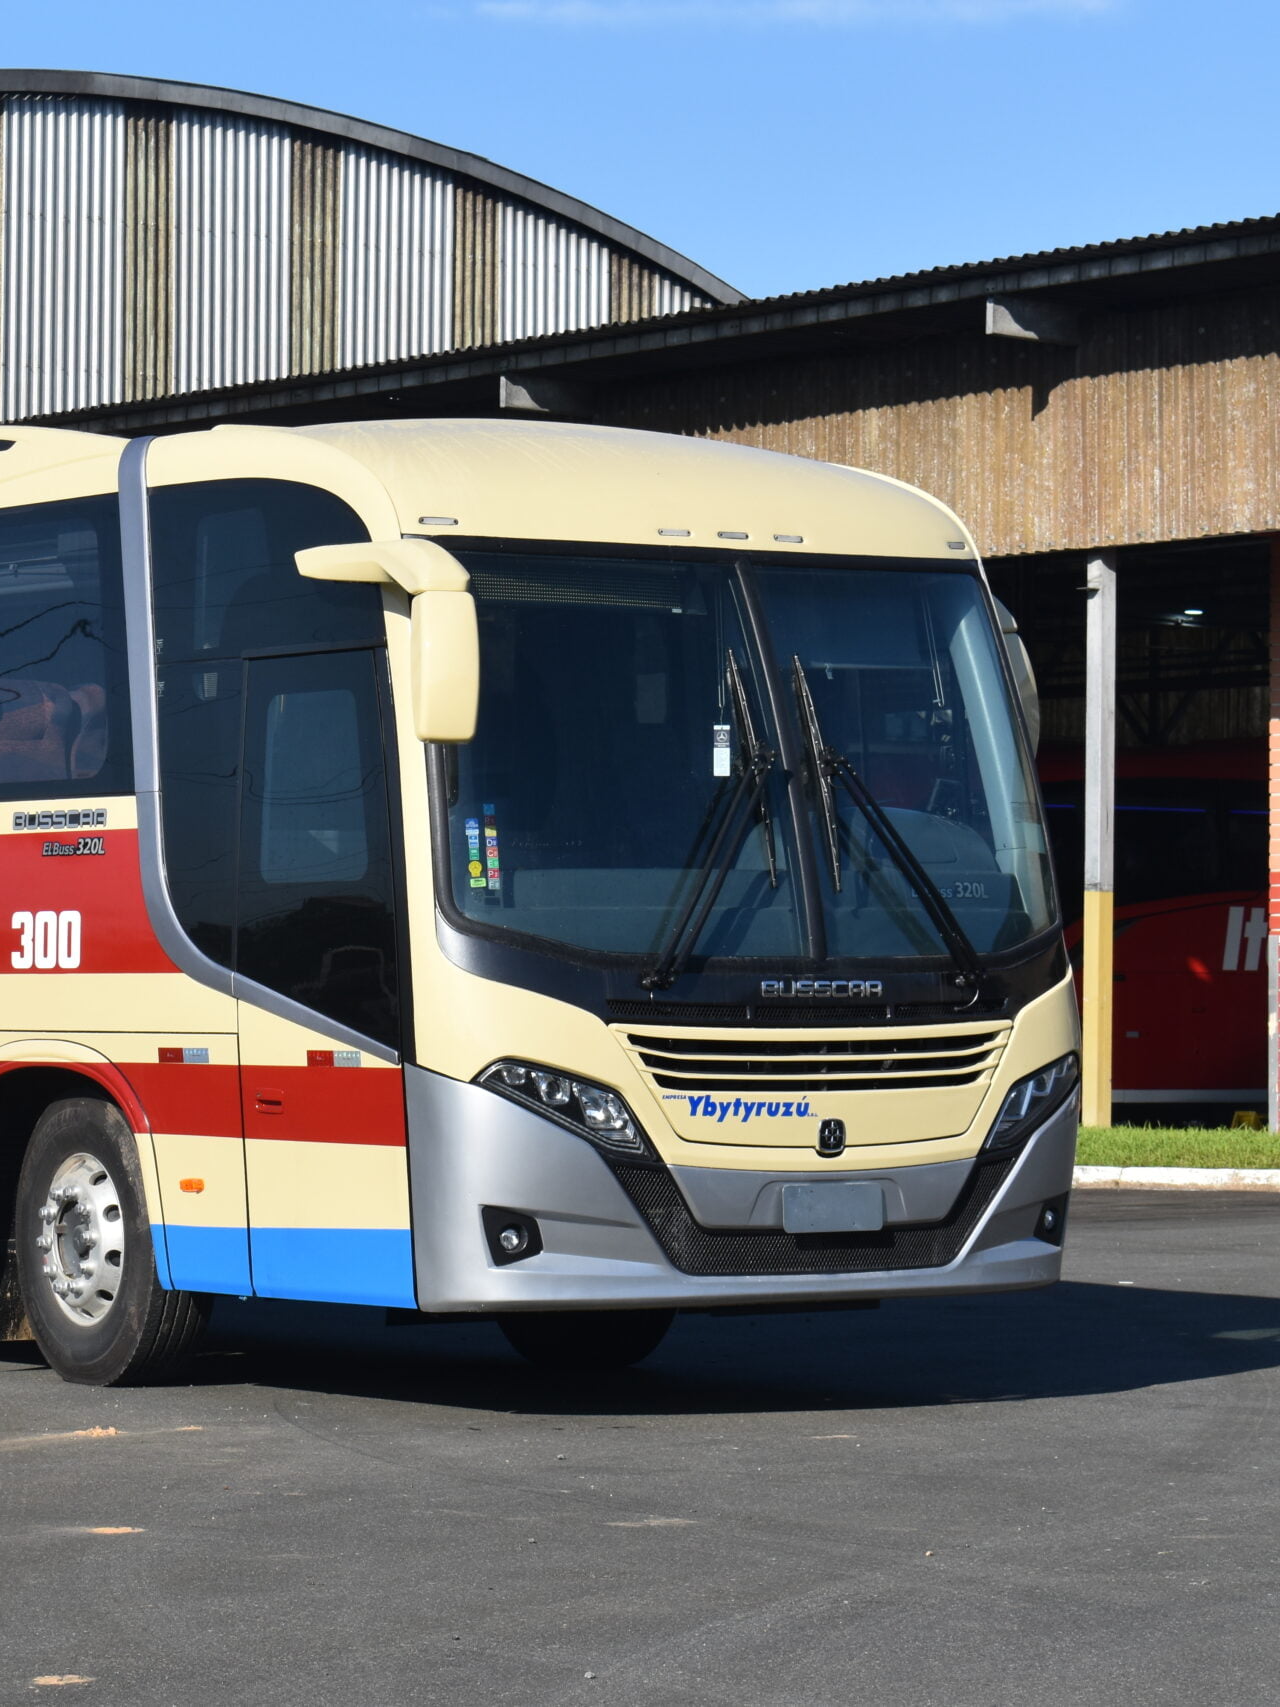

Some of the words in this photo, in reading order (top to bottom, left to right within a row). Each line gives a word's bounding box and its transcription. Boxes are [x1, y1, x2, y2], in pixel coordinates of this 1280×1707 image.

[12, 808, 107, 830] BUSSCAR
[42, 842, 52, 856] El
[53, 842, 74, 856] Buss
[75, 837, 105, 855] 320L
[955, 882, 989, 899] 320L
[11, 910, 81, 969] 300
[761, 980, 883, 998] BUSSCAR
[688, 1094, 810, 1123] Ybytyruzú
